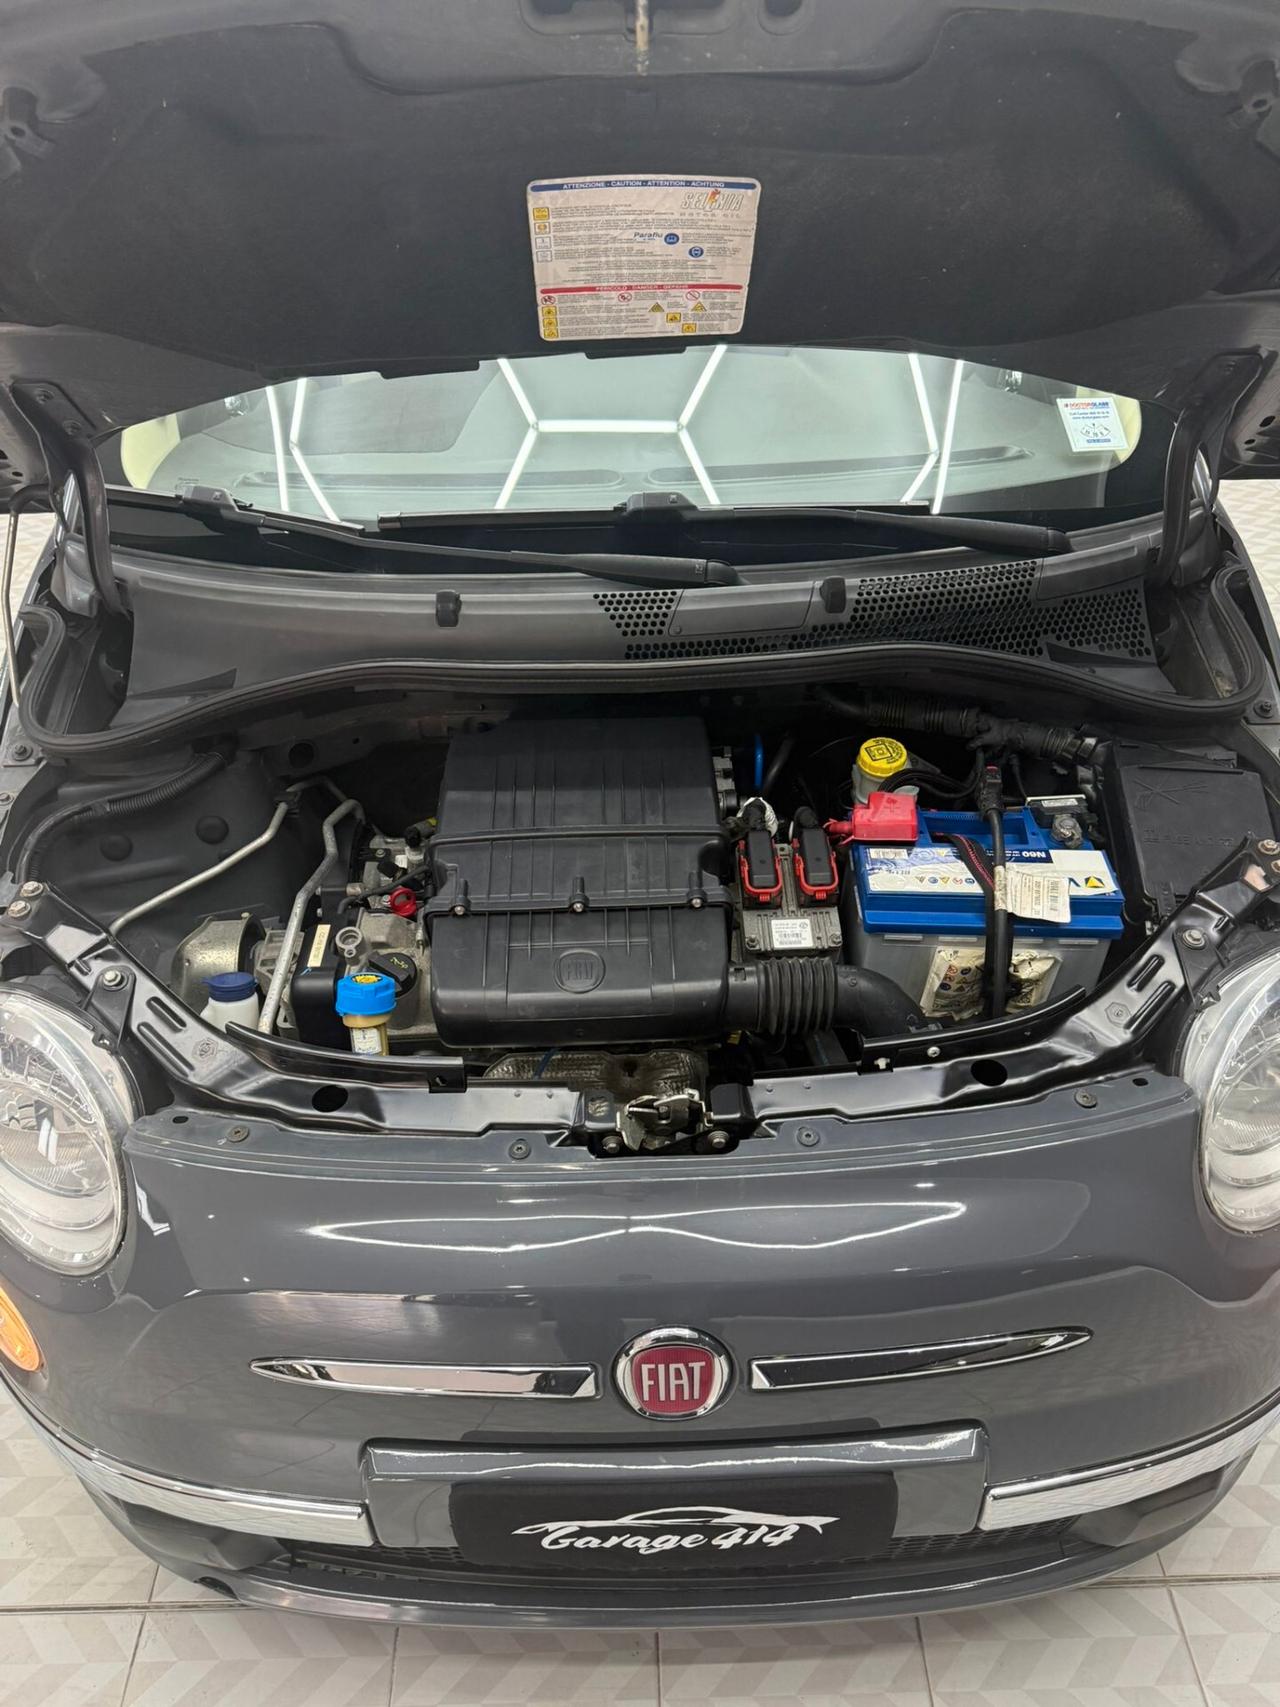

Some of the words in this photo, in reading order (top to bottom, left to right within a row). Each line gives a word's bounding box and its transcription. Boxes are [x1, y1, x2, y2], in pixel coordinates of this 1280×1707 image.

[562, 182, 606, 190] ATTENZIONE
[610, 180, 642, 188] CAUTION
[1021, 850, 1047, 859] N60
[641, 1361, 706, 1402] FIAT
[540, 1524, 708, 1554] Garage
[711, 1524, 800, 1550] 414
